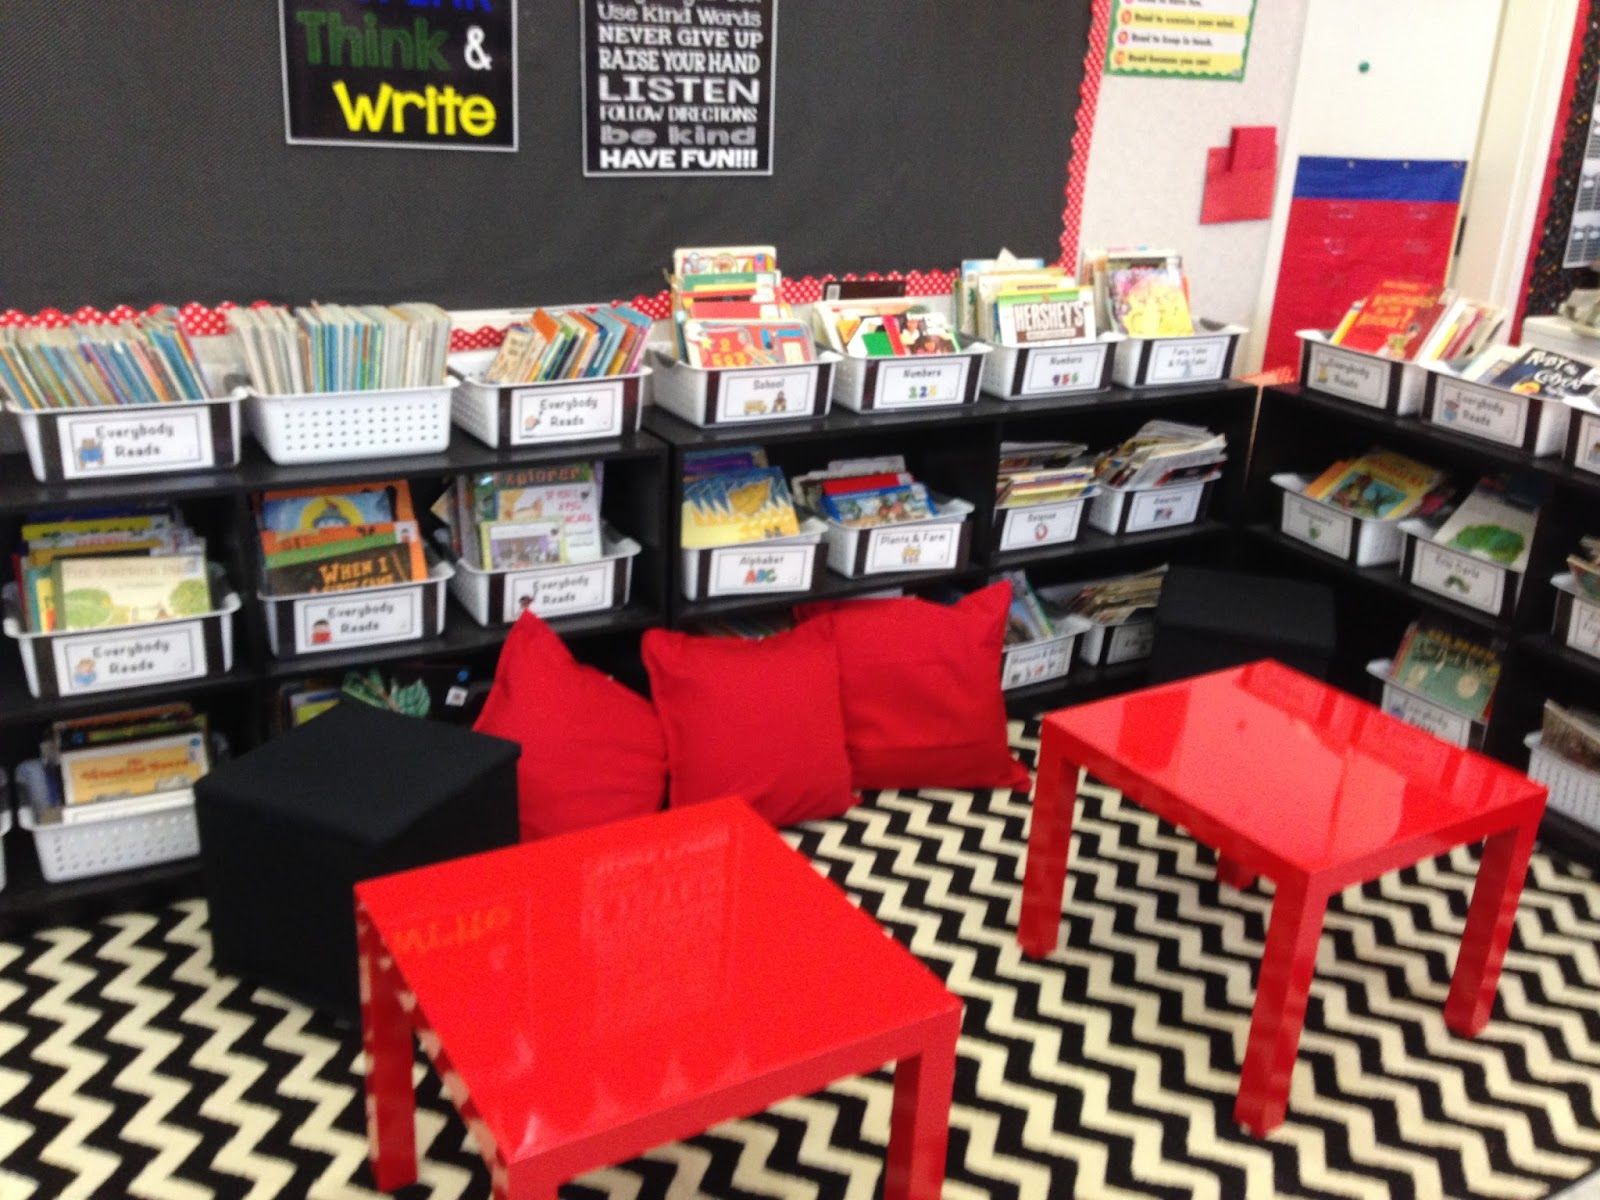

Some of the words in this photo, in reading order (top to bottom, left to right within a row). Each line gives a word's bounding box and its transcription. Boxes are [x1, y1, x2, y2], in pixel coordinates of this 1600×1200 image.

[597, 4, 638, 21] Use
[642, 7, 692, 24] Kind
[696, 7, 762, 27] Words
[296, 10, 450, 71] Think
[464, 24, 492, 71] &
[598, 25, 672, 45] NEVER
[677, 28, 729, 48] GIVE
[734, 29, 764, 49] UP
[599, 48, 660, 72] RAISE
[662, 50, 705, 73] YOUR
[708, 52, 761, 75] HAND
[599, 74, 760, 105] LISTEN
[332, 80, 497, 137] Write
[600, 104, 665, 122] FOLLOW
[668, 105, 758, 123] DIRECTIONS
[600, 124, 658, 145] be
[668, 125, 757, 146] kind
[600, 148, 676, 170] HAVE
[681, 148, 758, 169] FUN!!!
[1014, 301, 1084, 332] HERSHEY'S
[903, 368, 941, 379] Numbers
[753, 378, 784, 390] School
[540, 396, 598, 411] Everybody
[550, 416, 584, 427] Reads
[96, 422, 174, 439] Everybody
[115, 445, 160, 458] Reads
[912, 533, 920, 543] &
[739, 553, 784, 567] Alphabet
[318, 560, 373, 584] WHEN
[744, 568, 777, 584] ABC
[533, 575, 589, 592] Everybody
[542, 594, 576, 605] Reads
[328, 602, 394, 619] Everybody
[340, 621, 379, 634] Reads
[93, 639, 169, 658] Everybody
[109, 661, 154, 674] Reads
